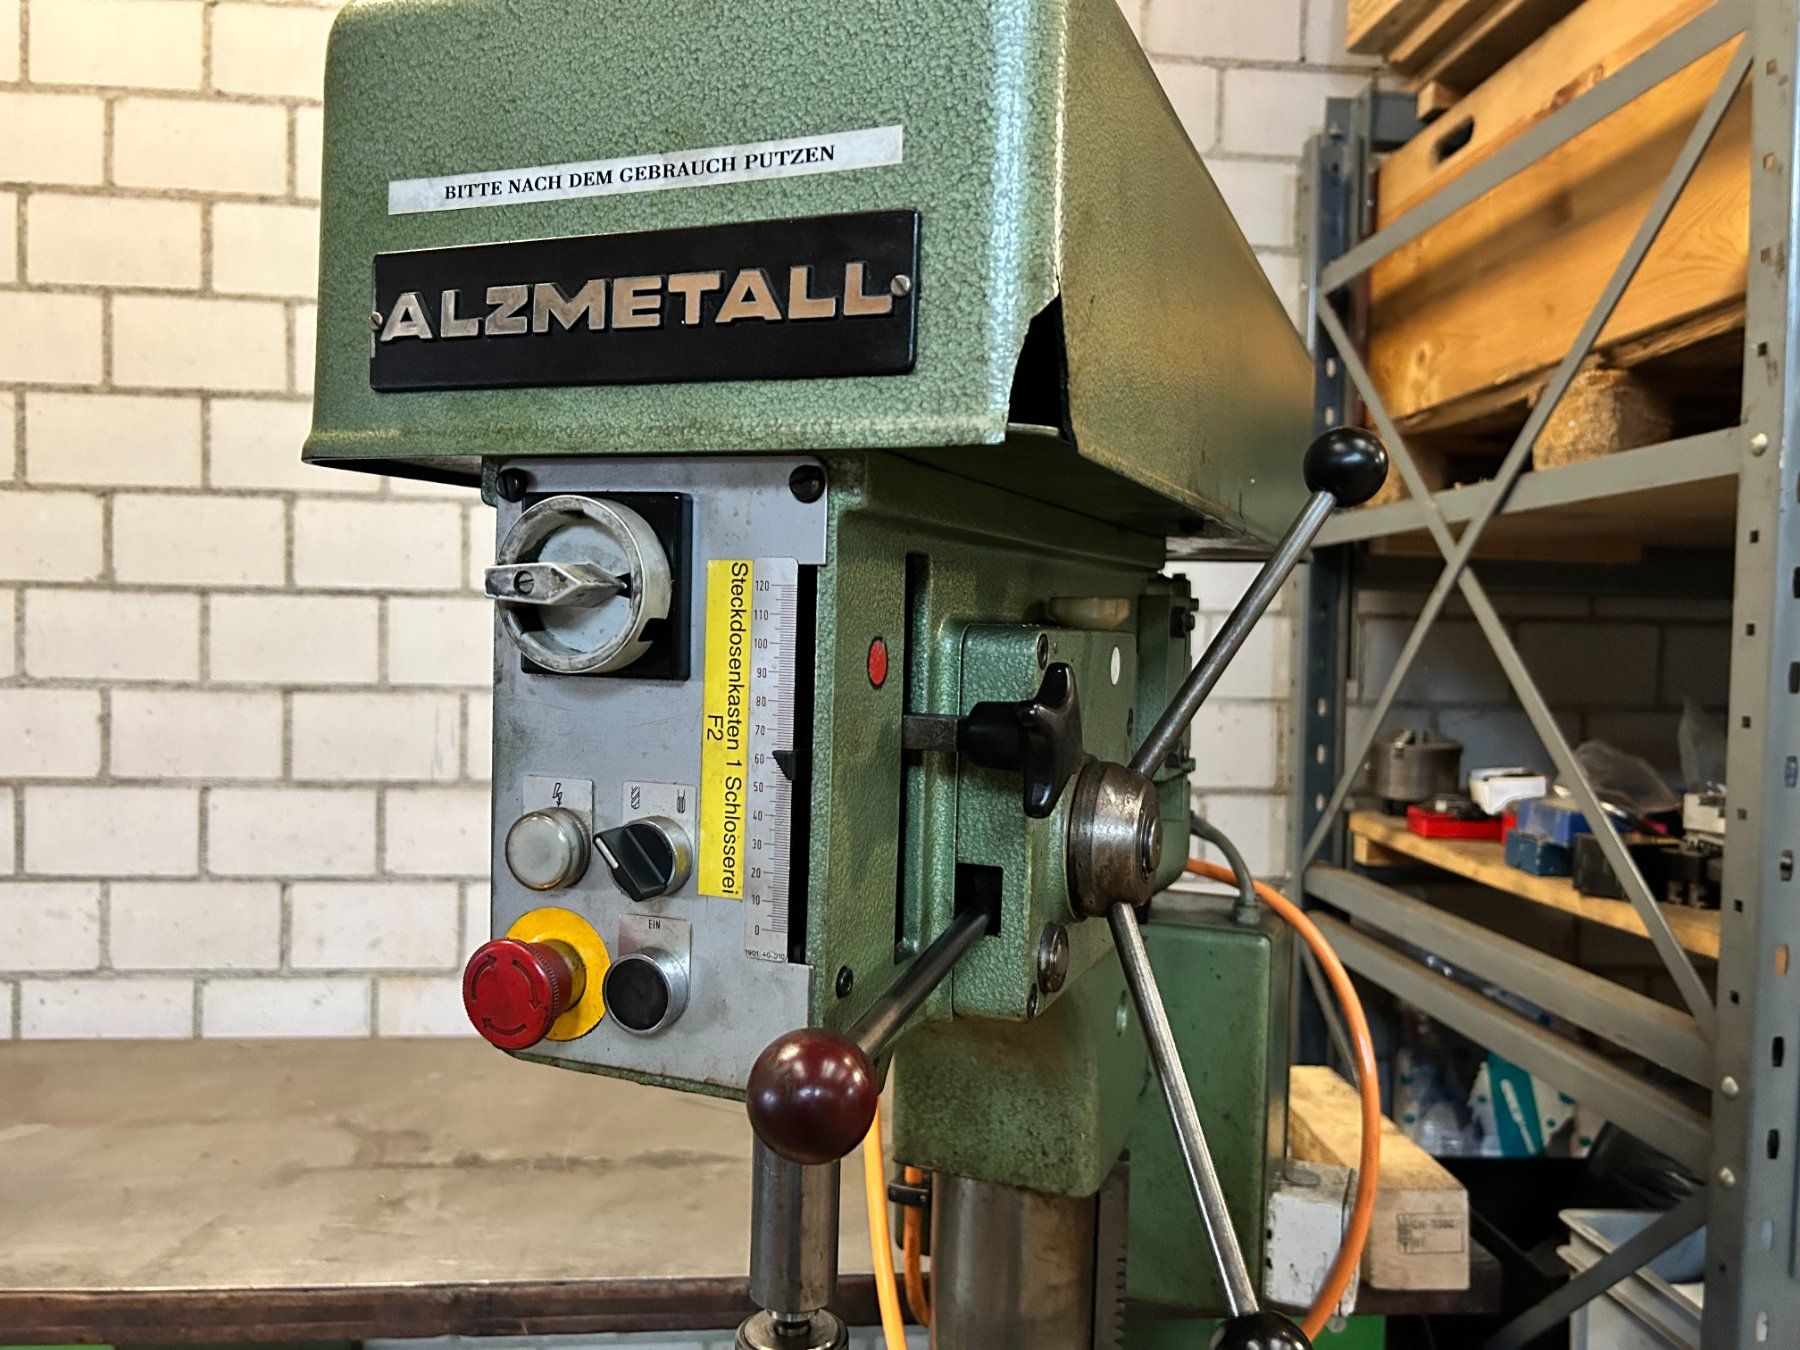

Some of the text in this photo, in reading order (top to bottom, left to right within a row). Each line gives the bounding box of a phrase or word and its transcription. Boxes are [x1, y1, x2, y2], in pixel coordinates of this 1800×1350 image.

[444, 144, 836, 200] BITTE NACH DEM GEBRAUCH PUTZEN
[379, 262, 894, 343] ALZMETALL
[755, 580, 770, 591] 120
[754, 610, 769, 621] 110
[754, 638, 768, 649] 100
[726, 562, 749, 750] Steckdosenkasten
[756, 668, 767, 678] 90
[756, 696, 767, 707] 80
[707, 714, 724, 741] F2
[755, 725, 766, 736] 70
[754, 753, 765, 764] 60
[753, 782, 764, 793] 50
[752, 810, 763, 821] 40
[722, 776, 742, 894] Schlosserei
[752, 839, 762, 850] 30
[751, 867, 761, 879] 20
[751, 895, 761, 906] 10
[648, 919, 661, 930] EIN
